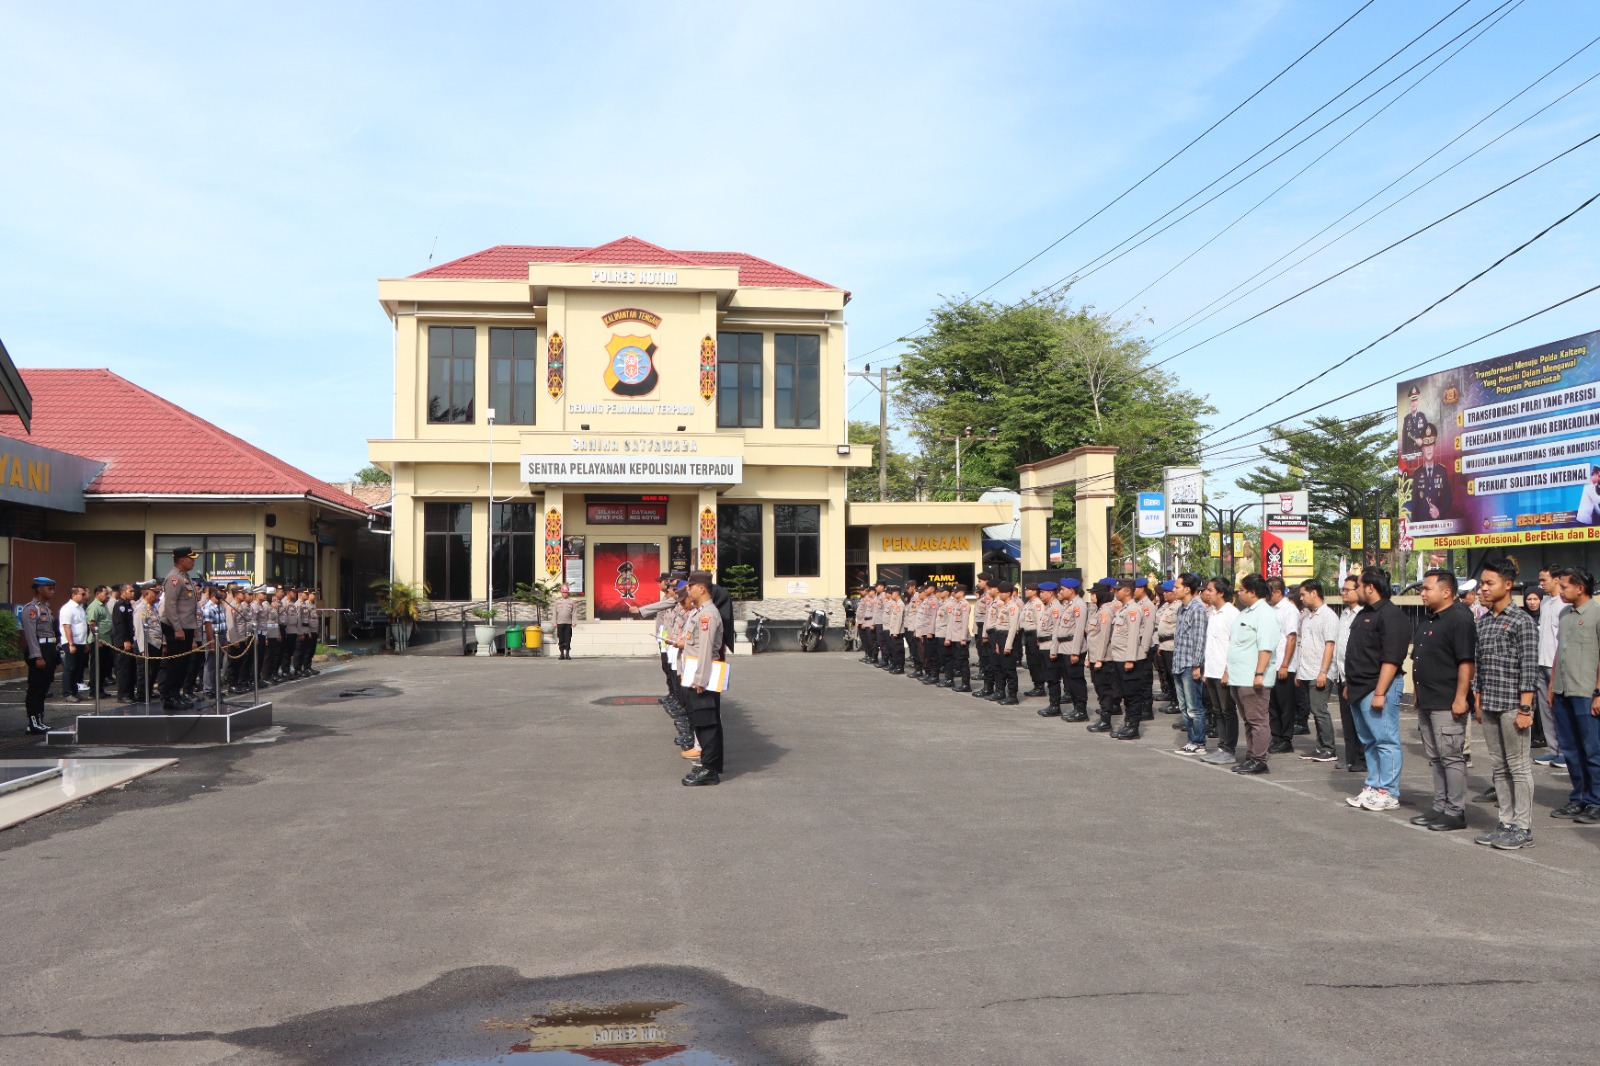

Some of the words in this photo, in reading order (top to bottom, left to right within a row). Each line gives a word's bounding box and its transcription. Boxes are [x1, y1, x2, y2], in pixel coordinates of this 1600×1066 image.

[592, 270, 636, 284] POLRES
[640, 271, 677, 285] KOTIM
[603, 310, 637, 325] KALIMANTAN
[639, 312, 659, 325] TENGAH
[1475, 364, 1514, 380] Transformasi
[1515, 358, 1538, 371] Menuju
[1540, 352, 1558, 364] Polda
[1559, 346, 1587, 360] Kalteng
[1483, 377, 1497, 388] Yang
[1498, 372, 1520, 383] Presisi
[1521, 368, 1541, 379] Dalam
[1543, 358, 1577, 374] Mengawal
[1496, 383, 1522, 395] Program
[1524, 374, 1562, 388] Pemerintah
[569, 404, 603, 414] GEDUNG
[606, 404, 655, 415] PELAYANAN
[656, 405, 695, 416] TERPADU
[1467, 404, 1519, 423] TRANSFORMASI
[1520, 399, 1541, 414] POLRI
[1543, 394, 1562, 409] YANG
[1564, 387, 1597, 404] PRESISI
[1465, 430, 1501, 447] PENEGAKAN
[1502, 426, 1527, 441] HUKUM
[1529, 421, 1547, 436] YANG
[1549, 413, 1600, 433] BERKEADILAN
[1498, 449, 1547, 464] HARKAMTIBMAS
[1548, 446, 1565, 457] YANG
[528, 462, 567, 475] SENTRA
[569, 463, 626, 475] PELAYANAN
[629, 463, 687, 476] KEPOLISIAN
[690, 463, 734, 476] TERPADU
[1478, 478, 1508, 492] PERKUAT
[1510, 473, 1548, 489] SOLIDITAS
[1550, 468, 1588, 484] INTERNAL
[1525, 530, 1564, 542] BerEtika
[1568, 528, 1584, 540] dan
[882, 536, 970, 552] PENJAGAAN
[928, 574, 955, 582] TAMU
